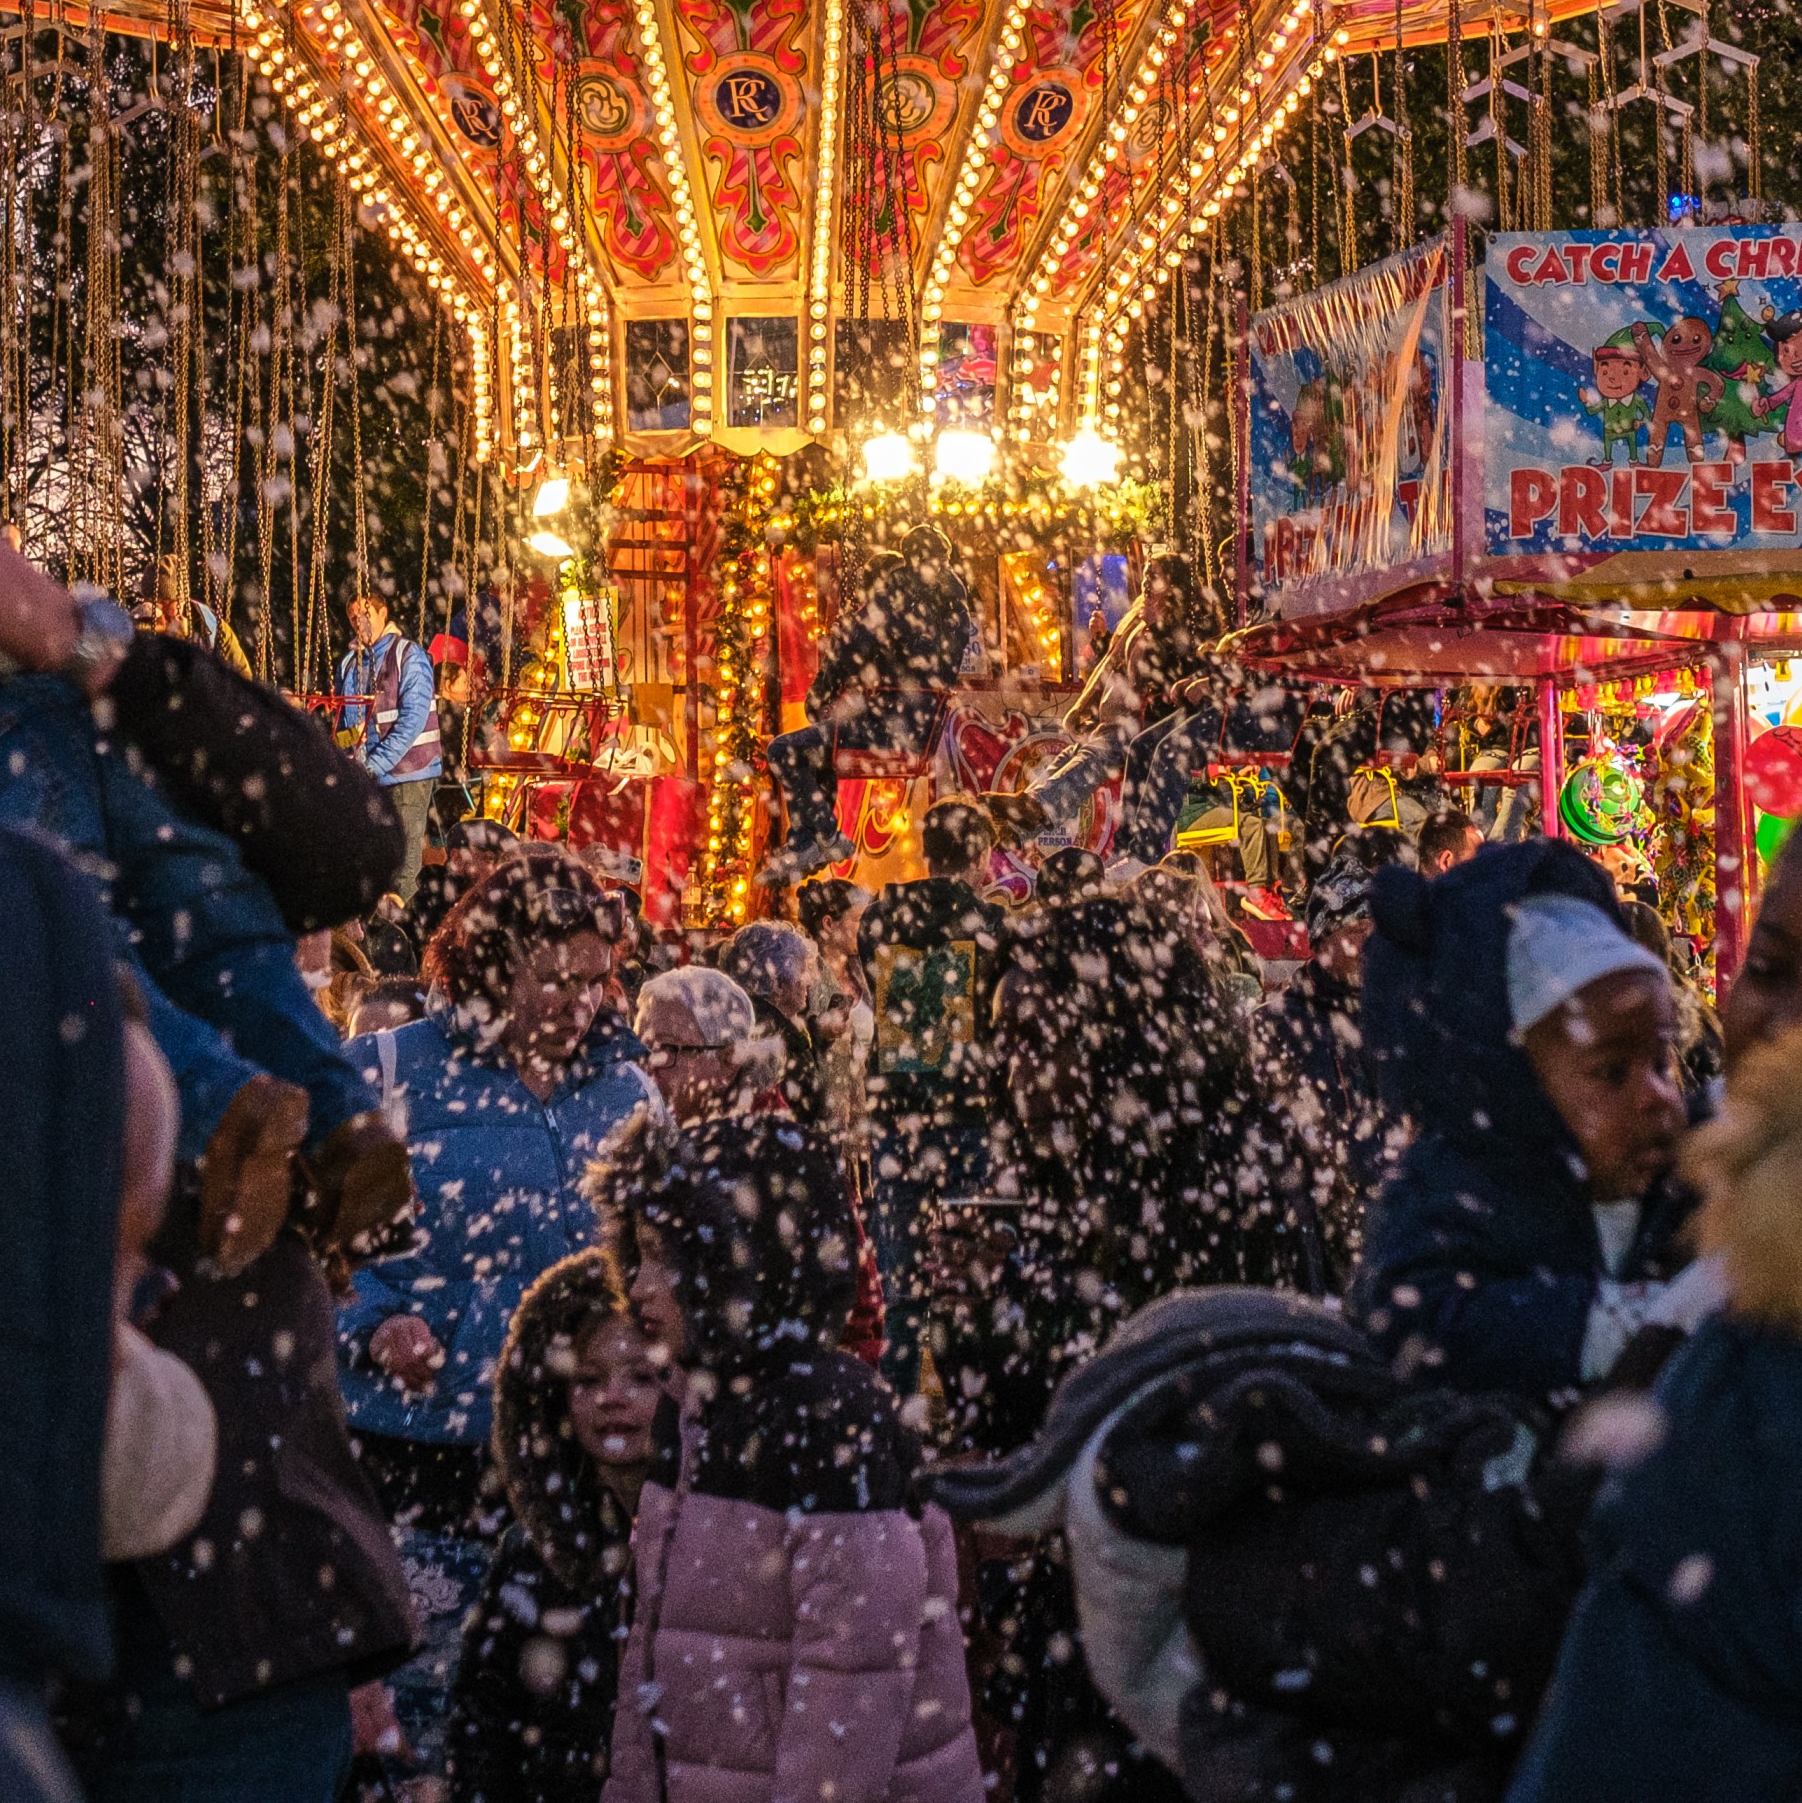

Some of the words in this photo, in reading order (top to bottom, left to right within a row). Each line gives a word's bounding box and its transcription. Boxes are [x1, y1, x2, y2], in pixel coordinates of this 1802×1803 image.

[1506, 241, 1655, 286] CATCH
[1659, 242, 1695, 283] A
[1510, 461, 1739, 539] PRIZE
[1038, 837, 1072, 846] PERSON
